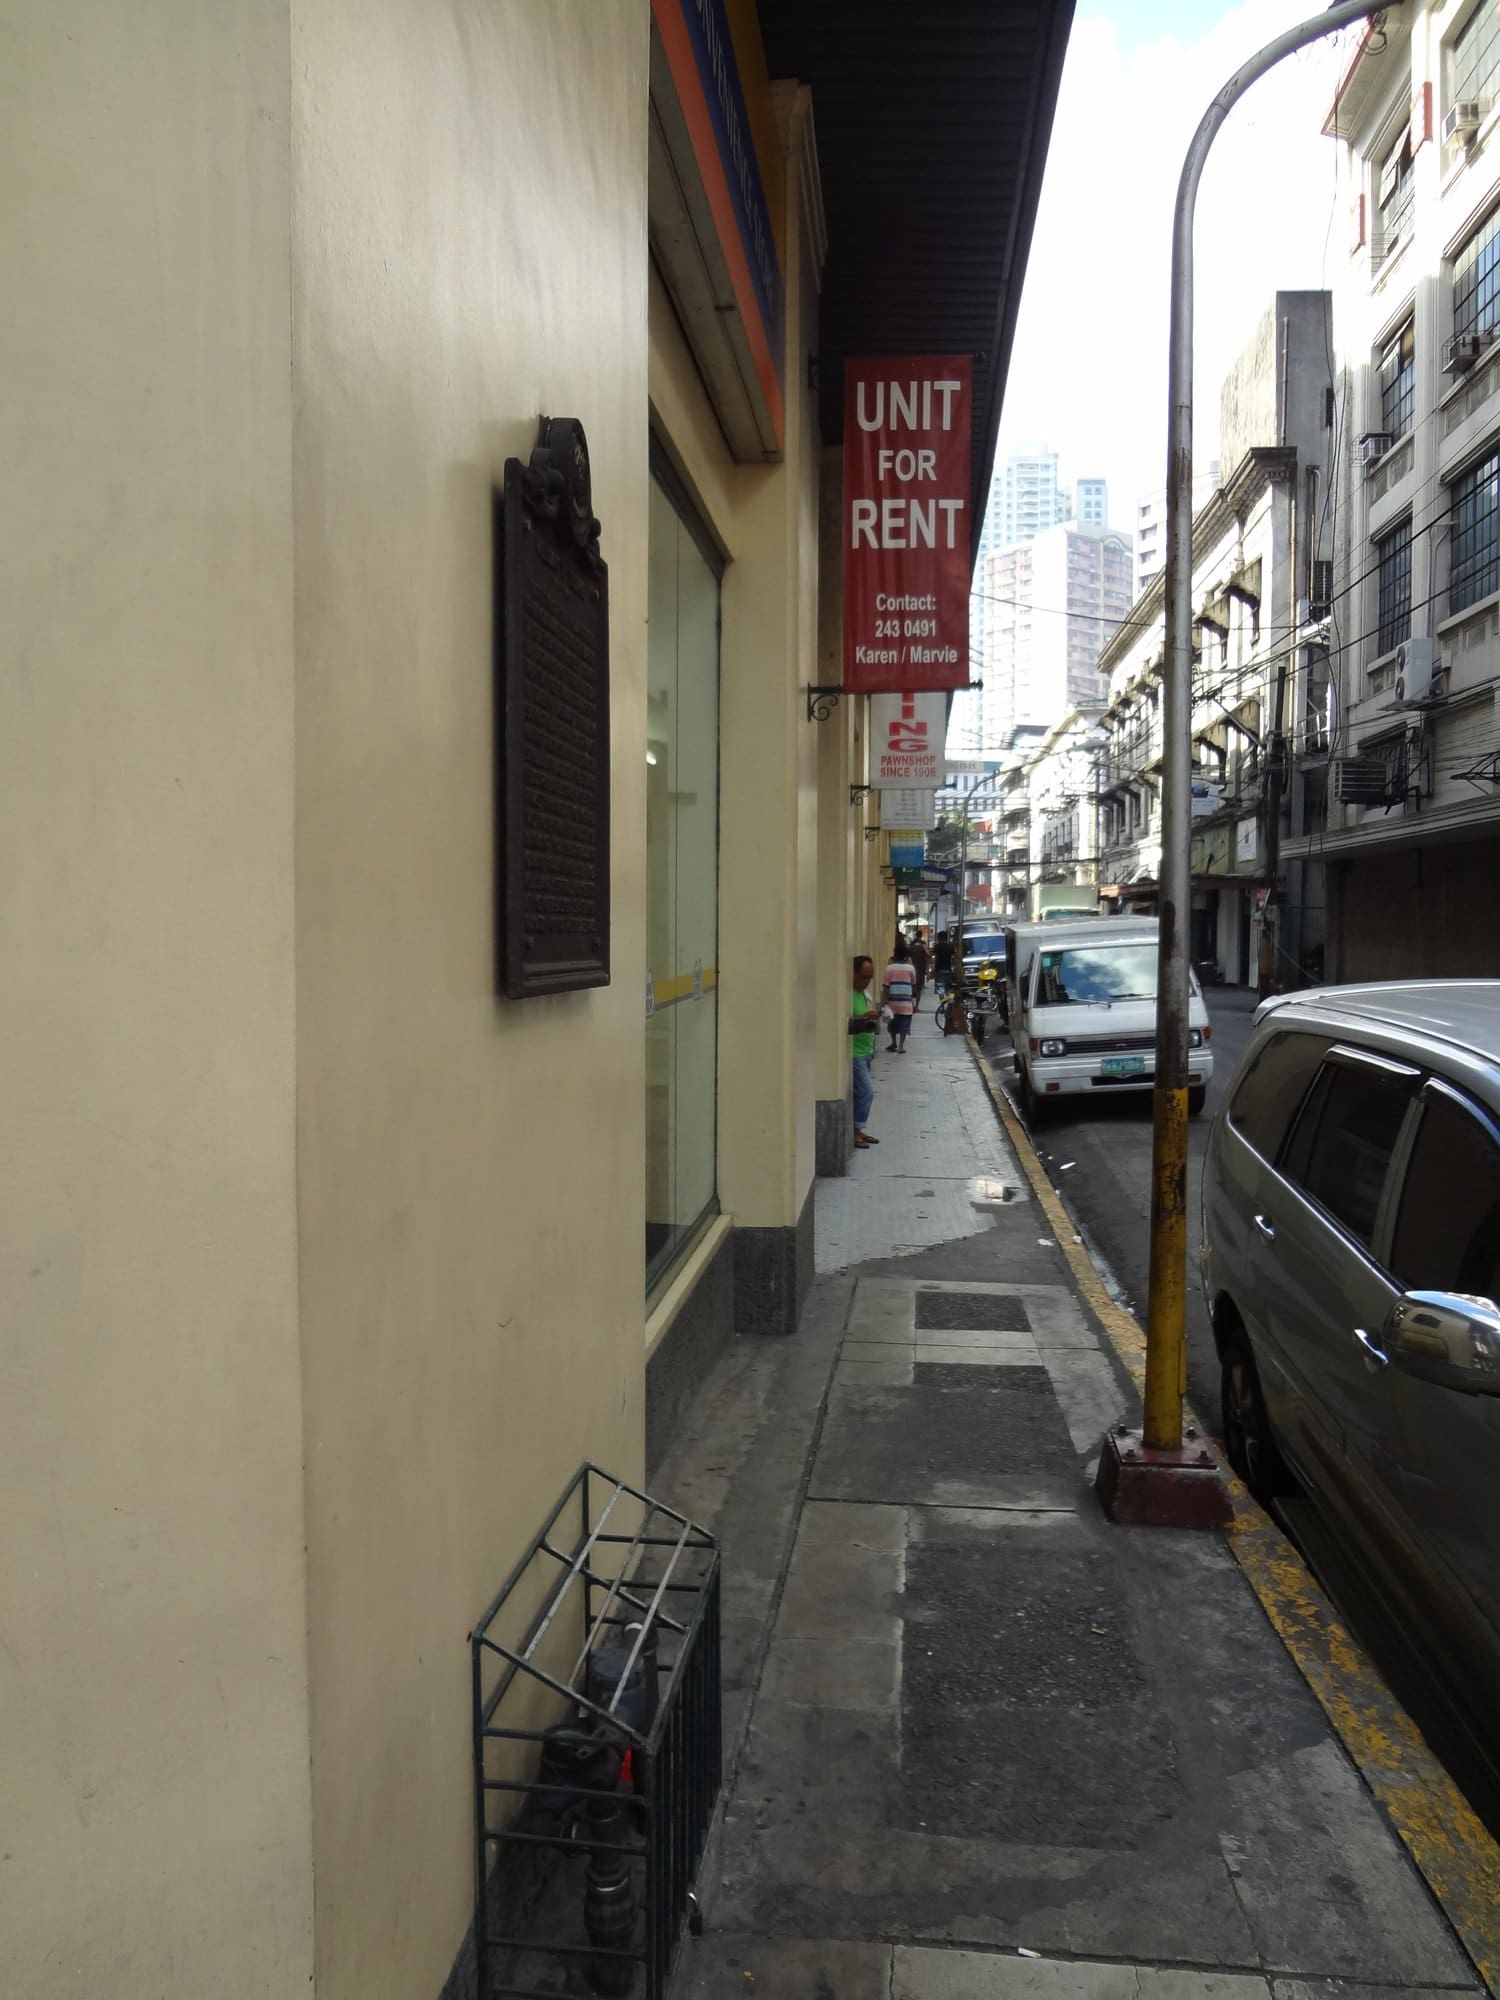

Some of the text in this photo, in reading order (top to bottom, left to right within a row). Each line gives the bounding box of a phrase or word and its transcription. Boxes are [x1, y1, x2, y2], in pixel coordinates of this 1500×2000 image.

[857, 380, 961, 432] UNIT
[878, 449, 937, 482] FOR
[851, 498, 964, 549] RENT
[876, 593, 936, 613] Contact:
[875, 619, 937, 638] 243 0491
[856, 644, 957, 664] Karen / Marvie
[880, 755, 936, 766] PAWNSHOP
[880, 766, 910, 777] SINCE
